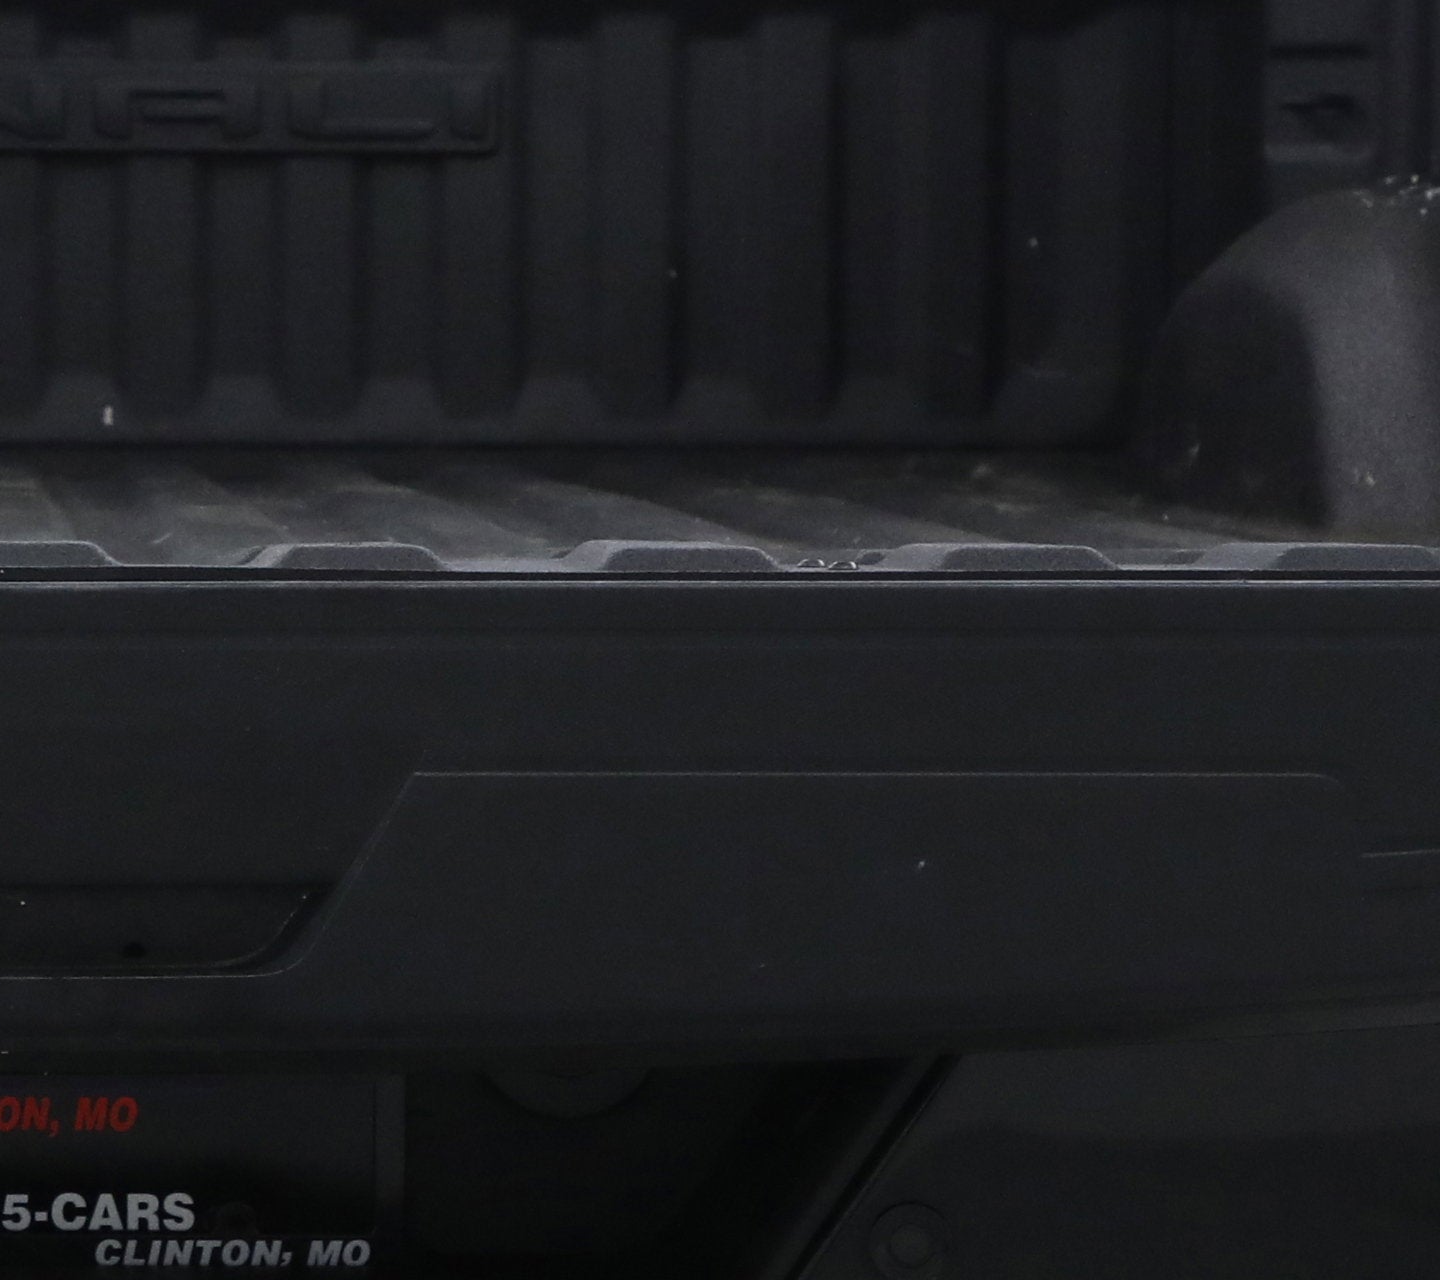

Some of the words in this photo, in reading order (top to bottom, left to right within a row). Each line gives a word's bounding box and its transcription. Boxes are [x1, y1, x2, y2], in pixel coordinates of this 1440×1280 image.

[74, 1096, 139, 1132] MO
[94, 1238, 293, 1267] CLINTON,
[307, 1238, 371, 1267] MO
